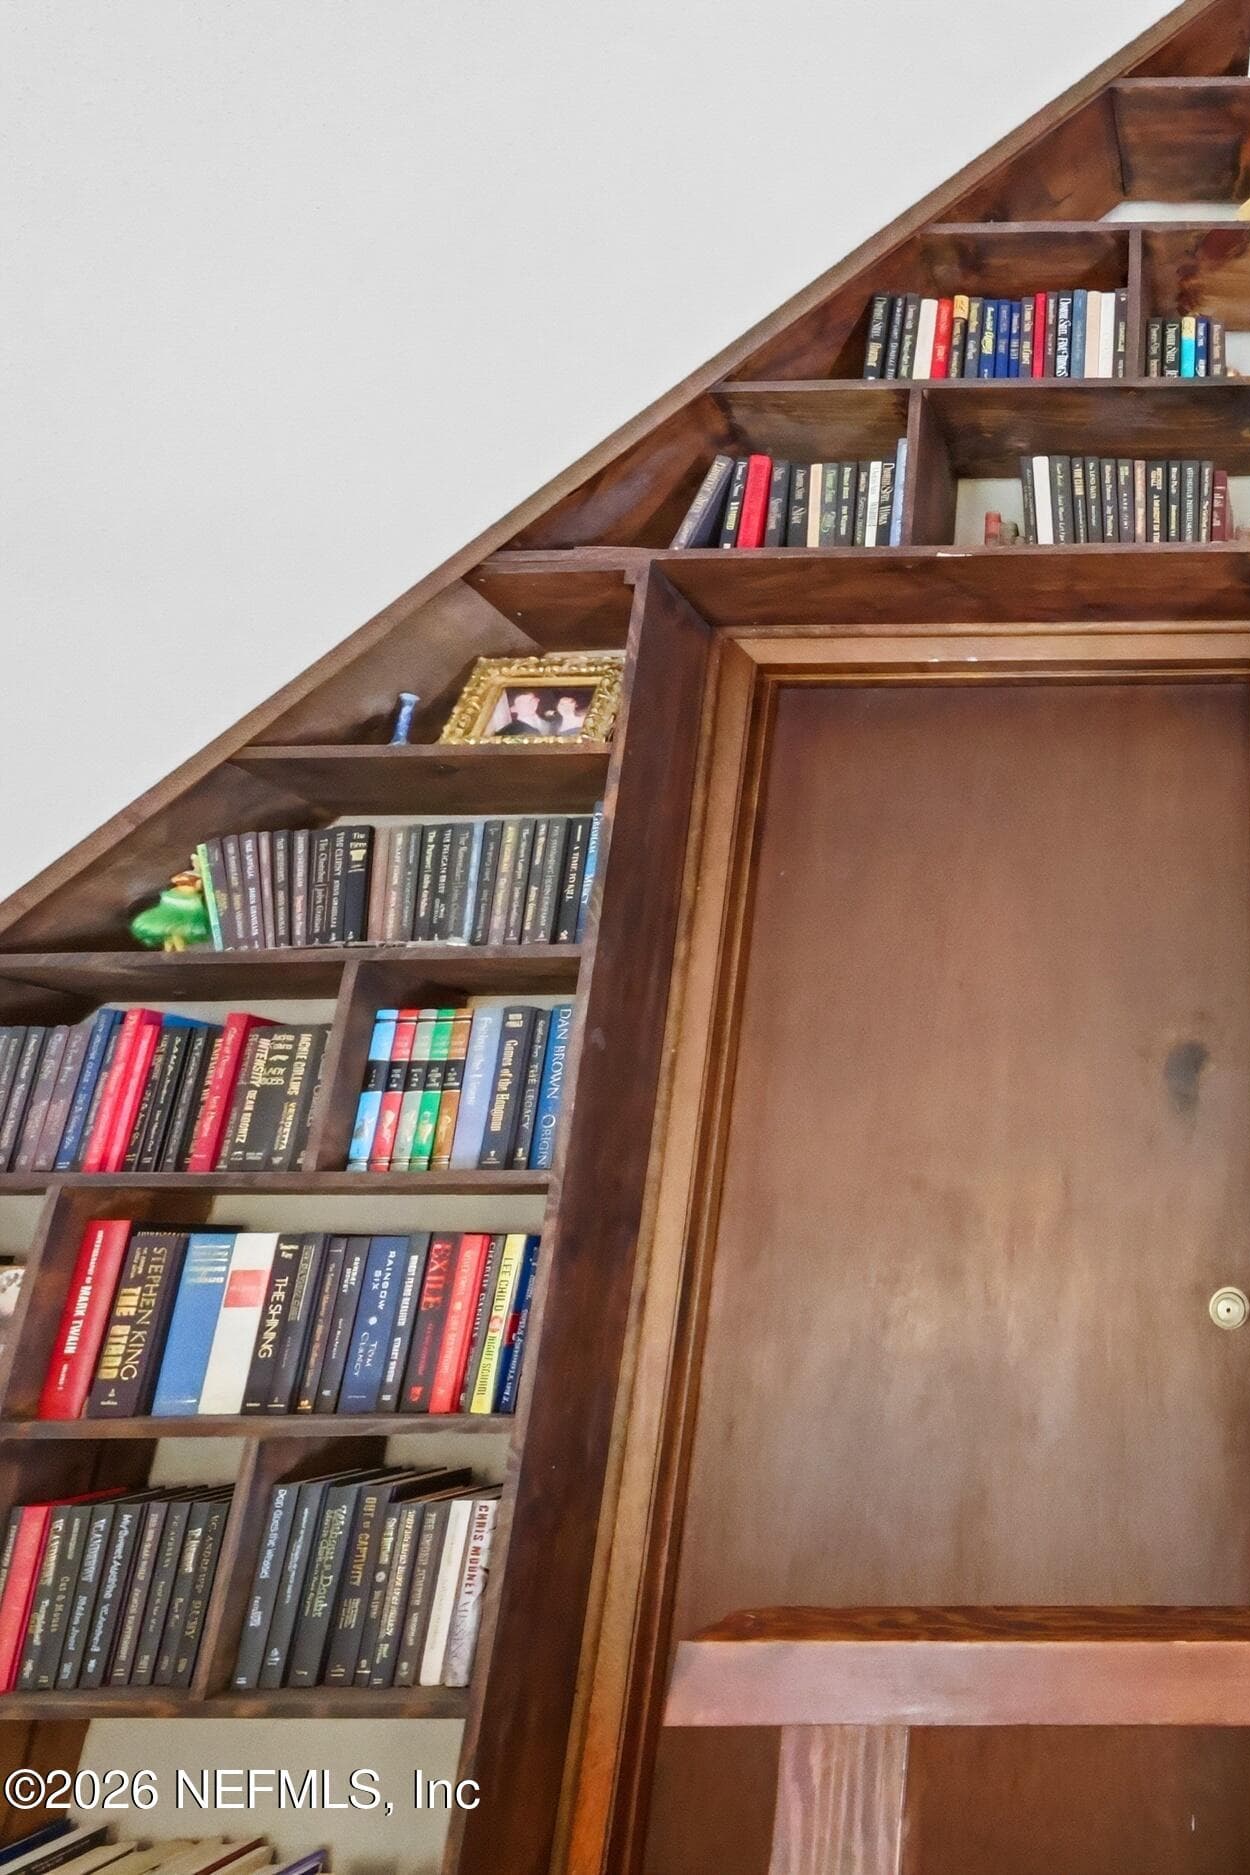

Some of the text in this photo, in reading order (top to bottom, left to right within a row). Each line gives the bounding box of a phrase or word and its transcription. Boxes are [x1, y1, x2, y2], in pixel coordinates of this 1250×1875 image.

[285, 1033, 312, 1096] JACKIE COLLINS
[499, 1067, 514, 1077] of
[500, 1039, 519, 1066] Games
[545, 1007, 572, 1099] DAN BROWN
[234, 1037, 271, 1143] INTENSITY DEAN KOONTZ
[497, 1077, 512, 1091] the
[277, 1101, 297, 1151] VENDETTA
[113, 1286, 142, 1316] THE
[270, 1276, 289, 1302] THE
[376, 1250, 397, 1310] RAINBOW
[419, 1240, 454, 1311] EXILE
[493, 1257, 514, 1312] LEE CHILD
[62, 1285, 93, 1354] MARK TWAIN
[117, 1246, 168, 1381] STEPHEN KING
[364, 1341, 378, 1367] TOM
[360, 1496, 378, 1517] OUT
[346, 1532, 371, 1587] CAPTIVITY
[462, 1504, 489, 1596] CHRIS MOONEY
